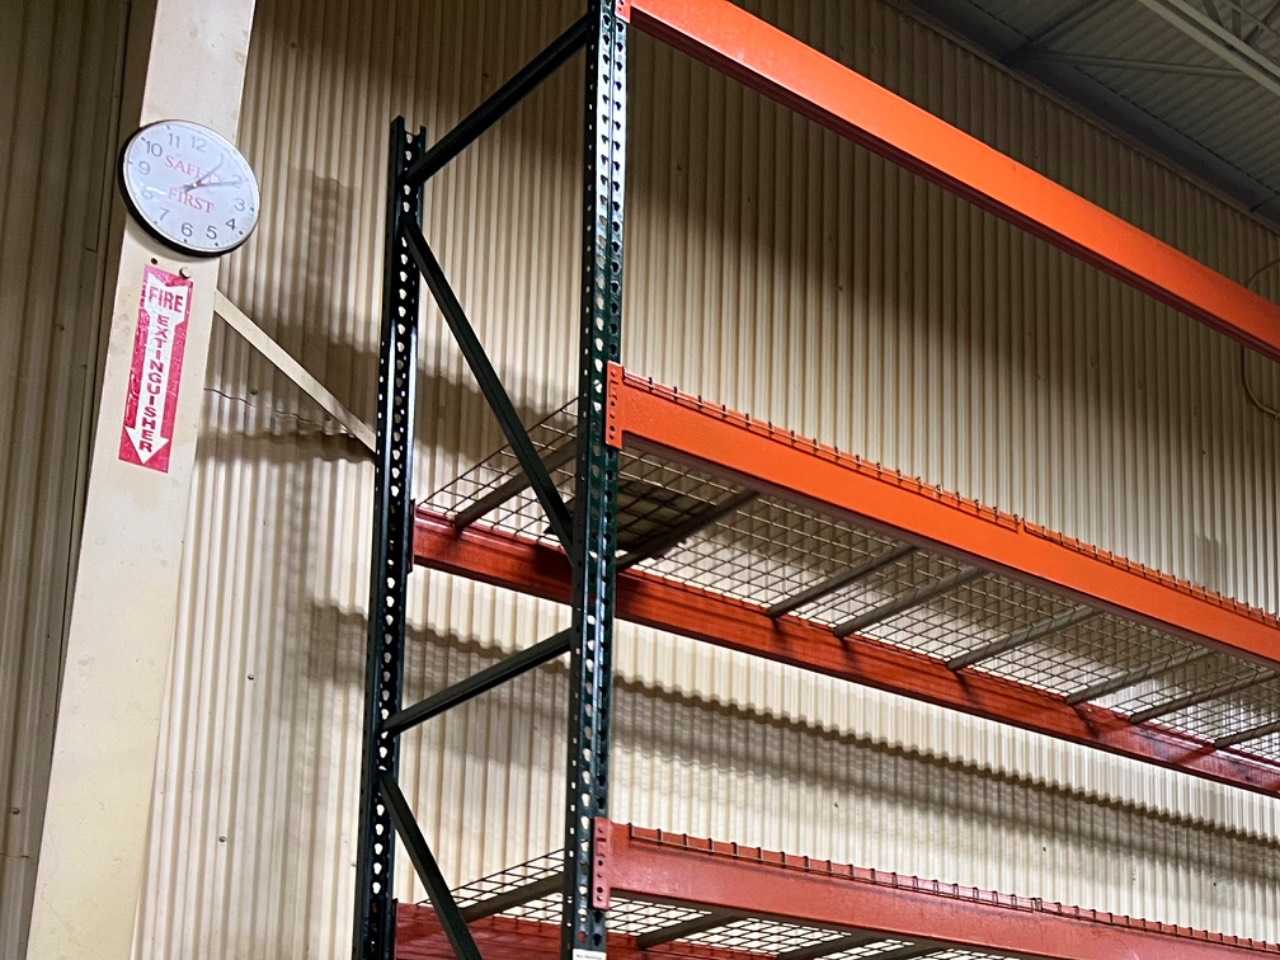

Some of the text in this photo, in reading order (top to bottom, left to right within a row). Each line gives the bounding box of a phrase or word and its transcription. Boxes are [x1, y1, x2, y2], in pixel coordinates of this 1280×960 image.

[169, 133, 181, 149] 11
[191, 136, 206, 151] 12
[146, 141, 163, 157] 10
[138, 161, 150, 175] 9
[168, 187, 215, 213] FIRST
[234, 198, 245, 212] 3
[160, 208, 170, 221] 7
[181, 222, 193, 237] 6
[225, 217, 236, 231] 4
[206, 225, 217, 240] 5
[148, 286, 184, 313] FIRE
[139, 315, 170, 453] EXTINGUISHER
